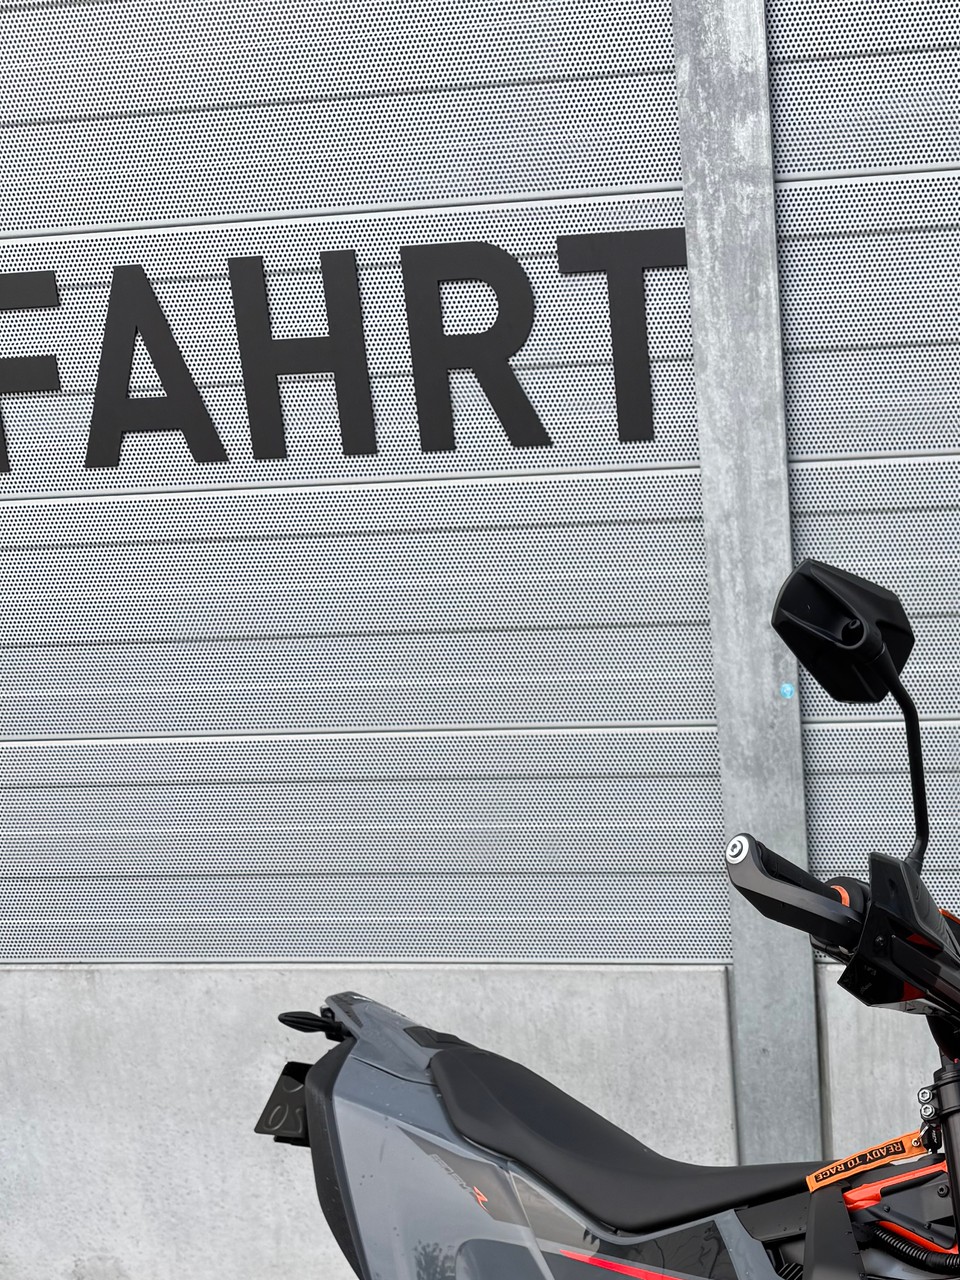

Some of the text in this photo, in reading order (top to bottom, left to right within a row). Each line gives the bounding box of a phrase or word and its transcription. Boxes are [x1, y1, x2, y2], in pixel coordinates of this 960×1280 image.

[816, 1141, 903, 1181] READY TO RACE
